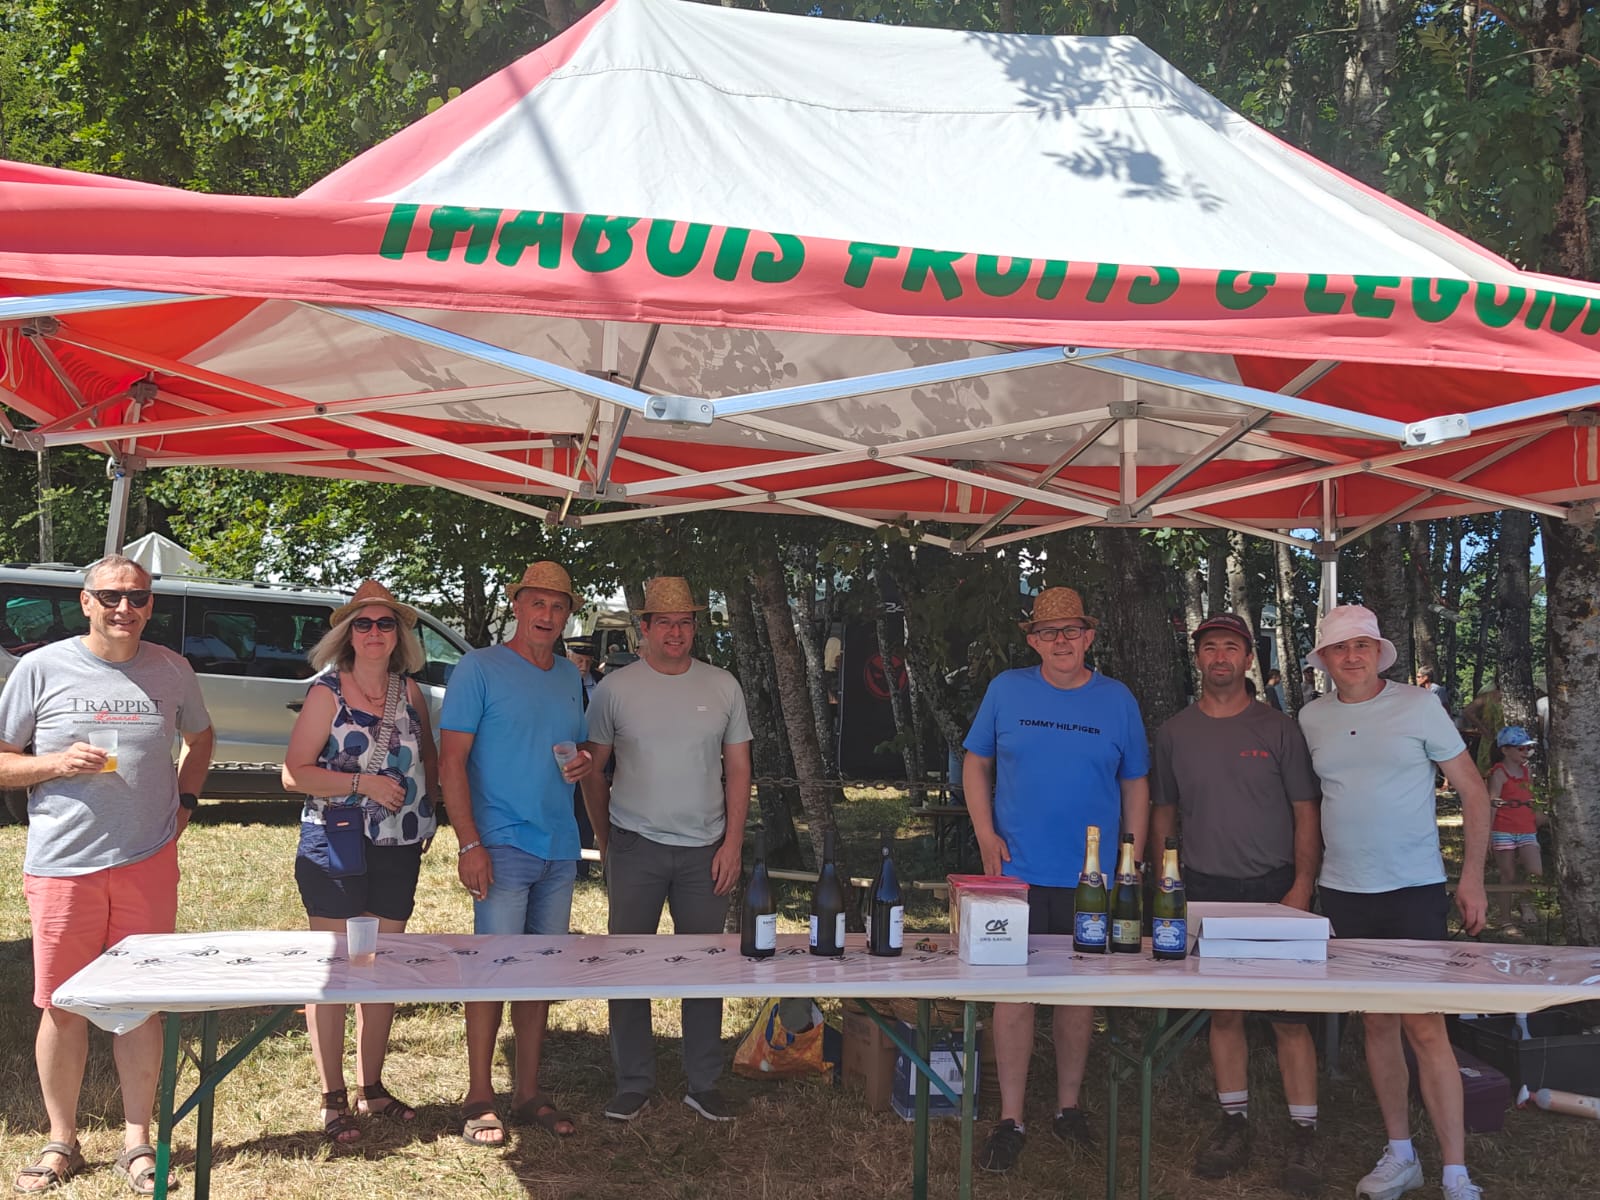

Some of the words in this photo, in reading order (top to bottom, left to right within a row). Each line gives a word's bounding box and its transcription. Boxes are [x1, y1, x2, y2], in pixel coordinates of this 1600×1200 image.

[67, 697, 163, 713] TRAPPIST
[1019, 719, 1055, 729] TOMMY
[1056, 722, 1101, 736] HILFIGER
